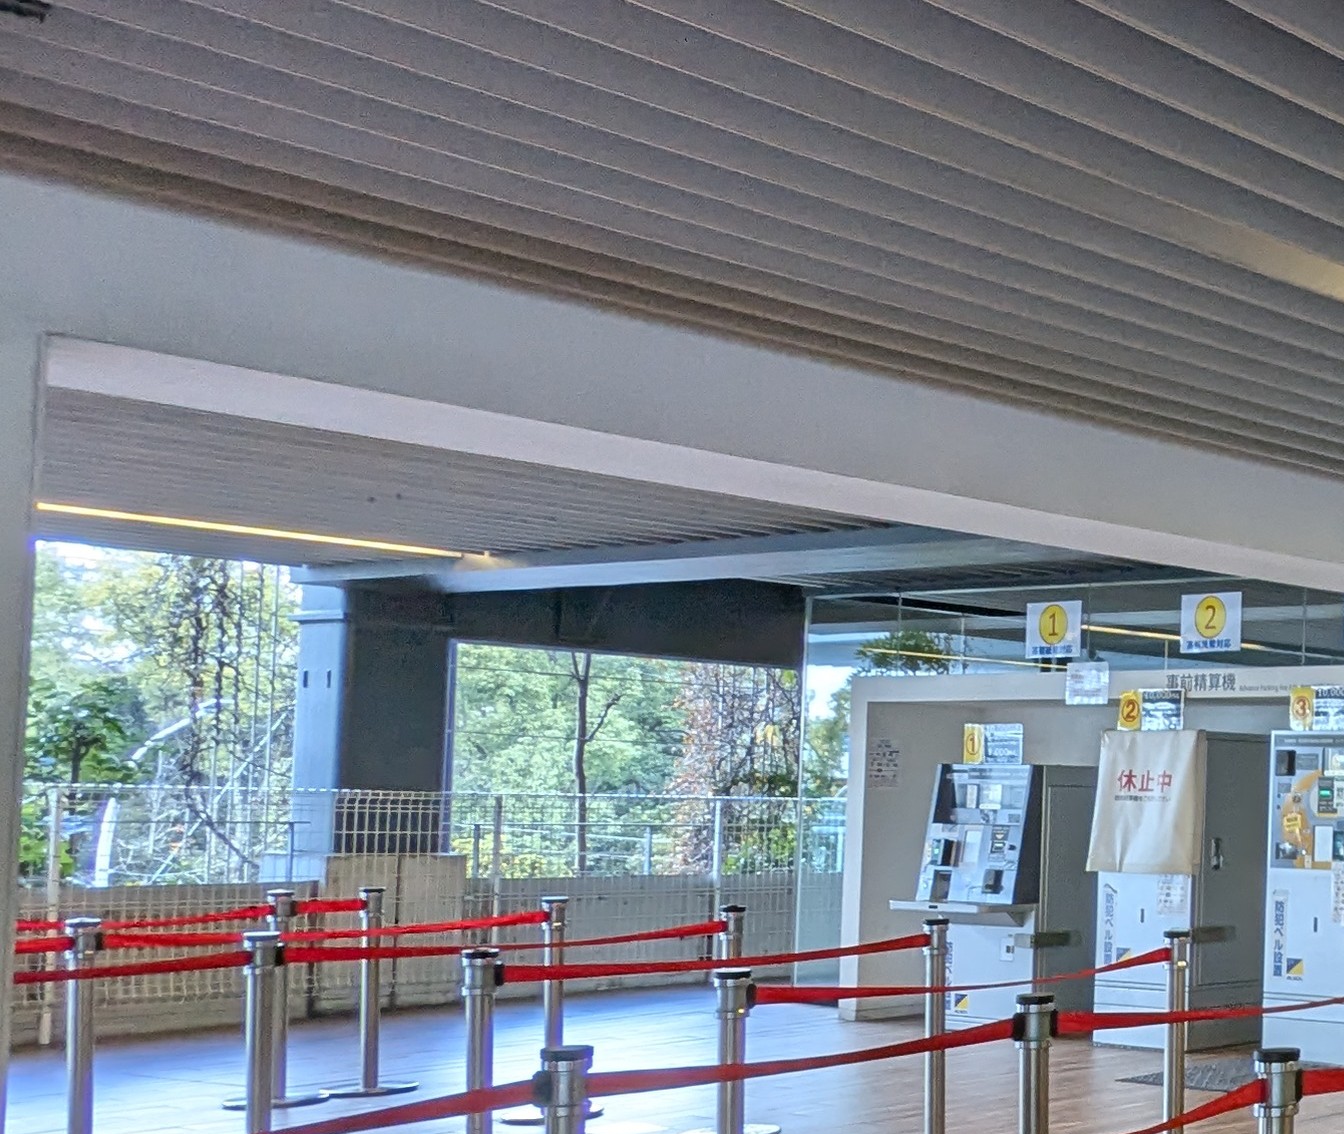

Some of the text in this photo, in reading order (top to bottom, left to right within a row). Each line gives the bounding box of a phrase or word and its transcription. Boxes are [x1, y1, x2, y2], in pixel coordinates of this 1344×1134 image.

[1048, 610, 1059, 637] 1
[1204, 604, 1217, 630] 2
[1166, 672, 1237, 692] 事前精算機
[1117, 768, 1173, 793] 休止中
